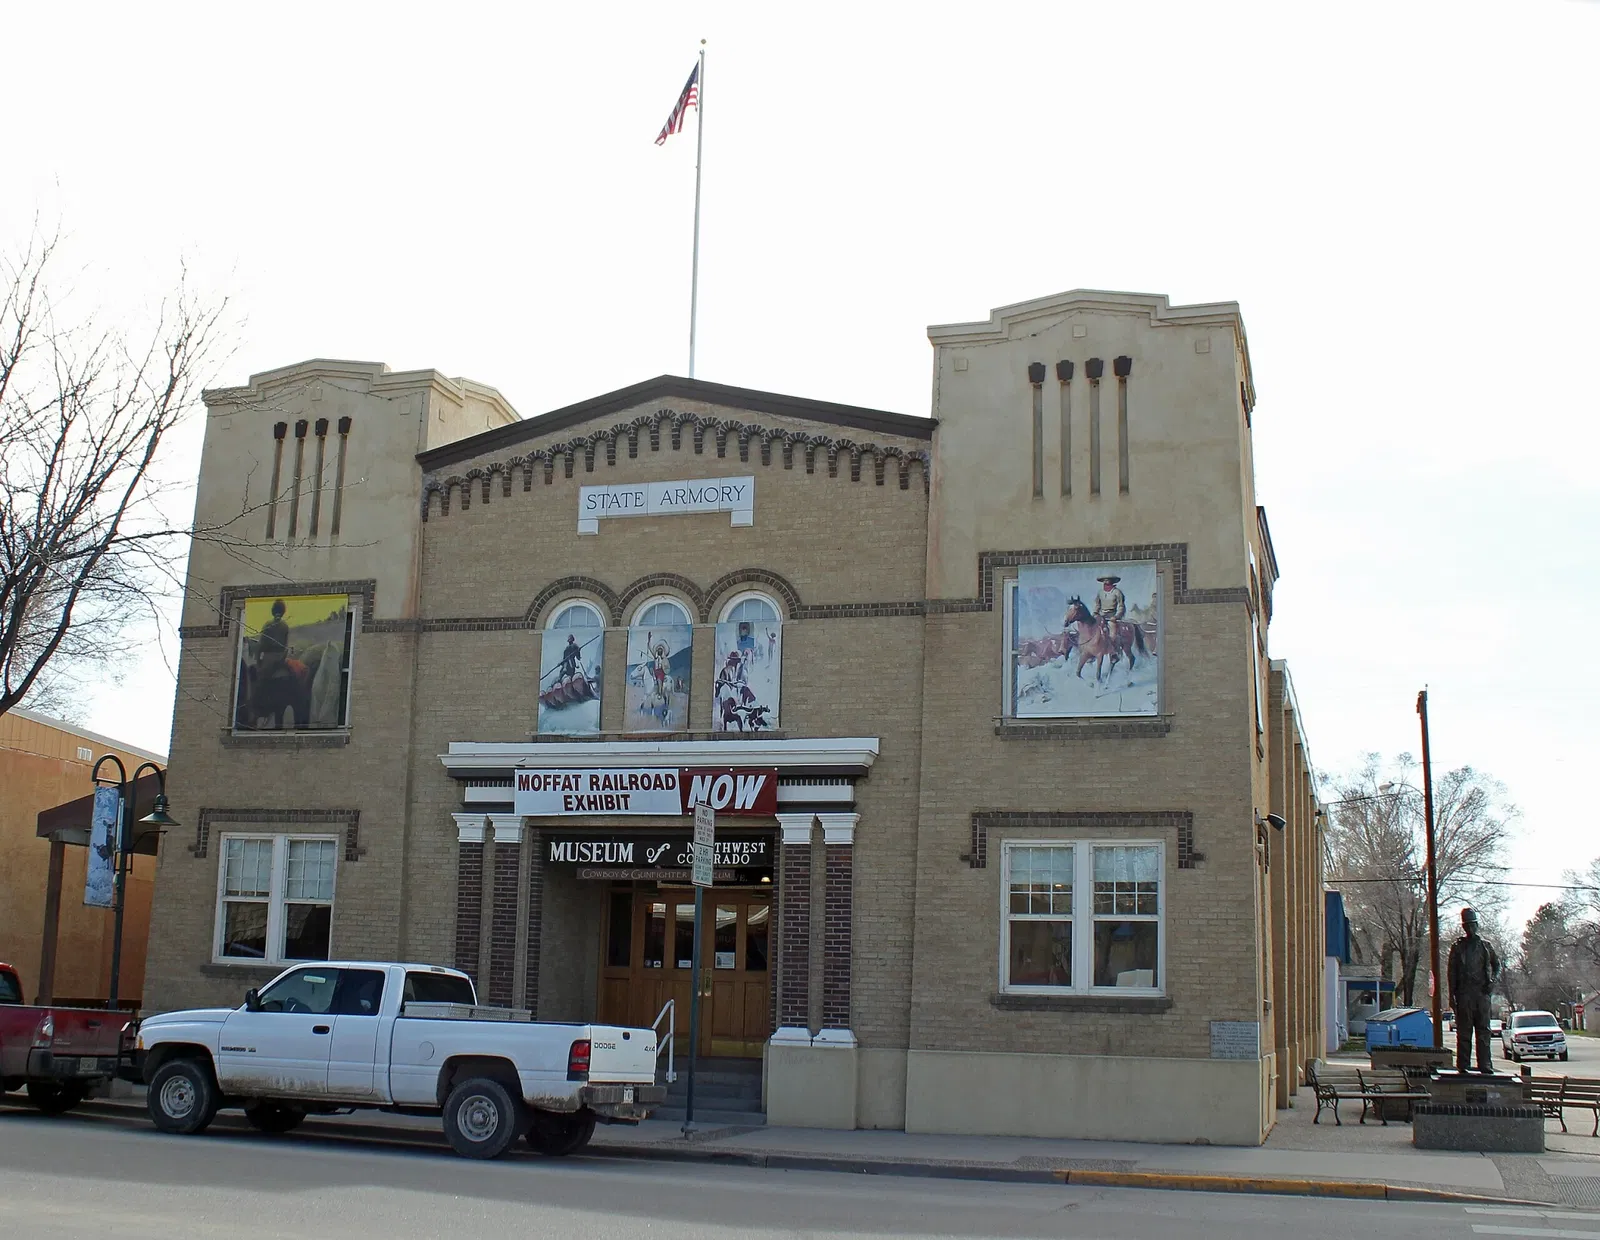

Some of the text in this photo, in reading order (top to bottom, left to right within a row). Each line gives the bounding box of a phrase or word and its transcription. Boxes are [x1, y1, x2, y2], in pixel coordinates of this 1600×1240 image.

[586, 485, 746, 510] STATE ARMORY
[518, 774, 676, 791] MOFFAT RAILROAD
[687, 774, 767, 810] NOW
[563, 794, 630, 811] EXHIBIT
[549, 842, 671, 863] MUSEUM of
[686, 842, 766, 853] NTHWEST
[677, 853, 750, 864] CORADO
[582, 868, 619, 879] COWBOY
[620, 869, 629, 878] &
[631, 869, 687, 879] GUNFIGHTER
[594, 1042, 615, 1050] DODGE
